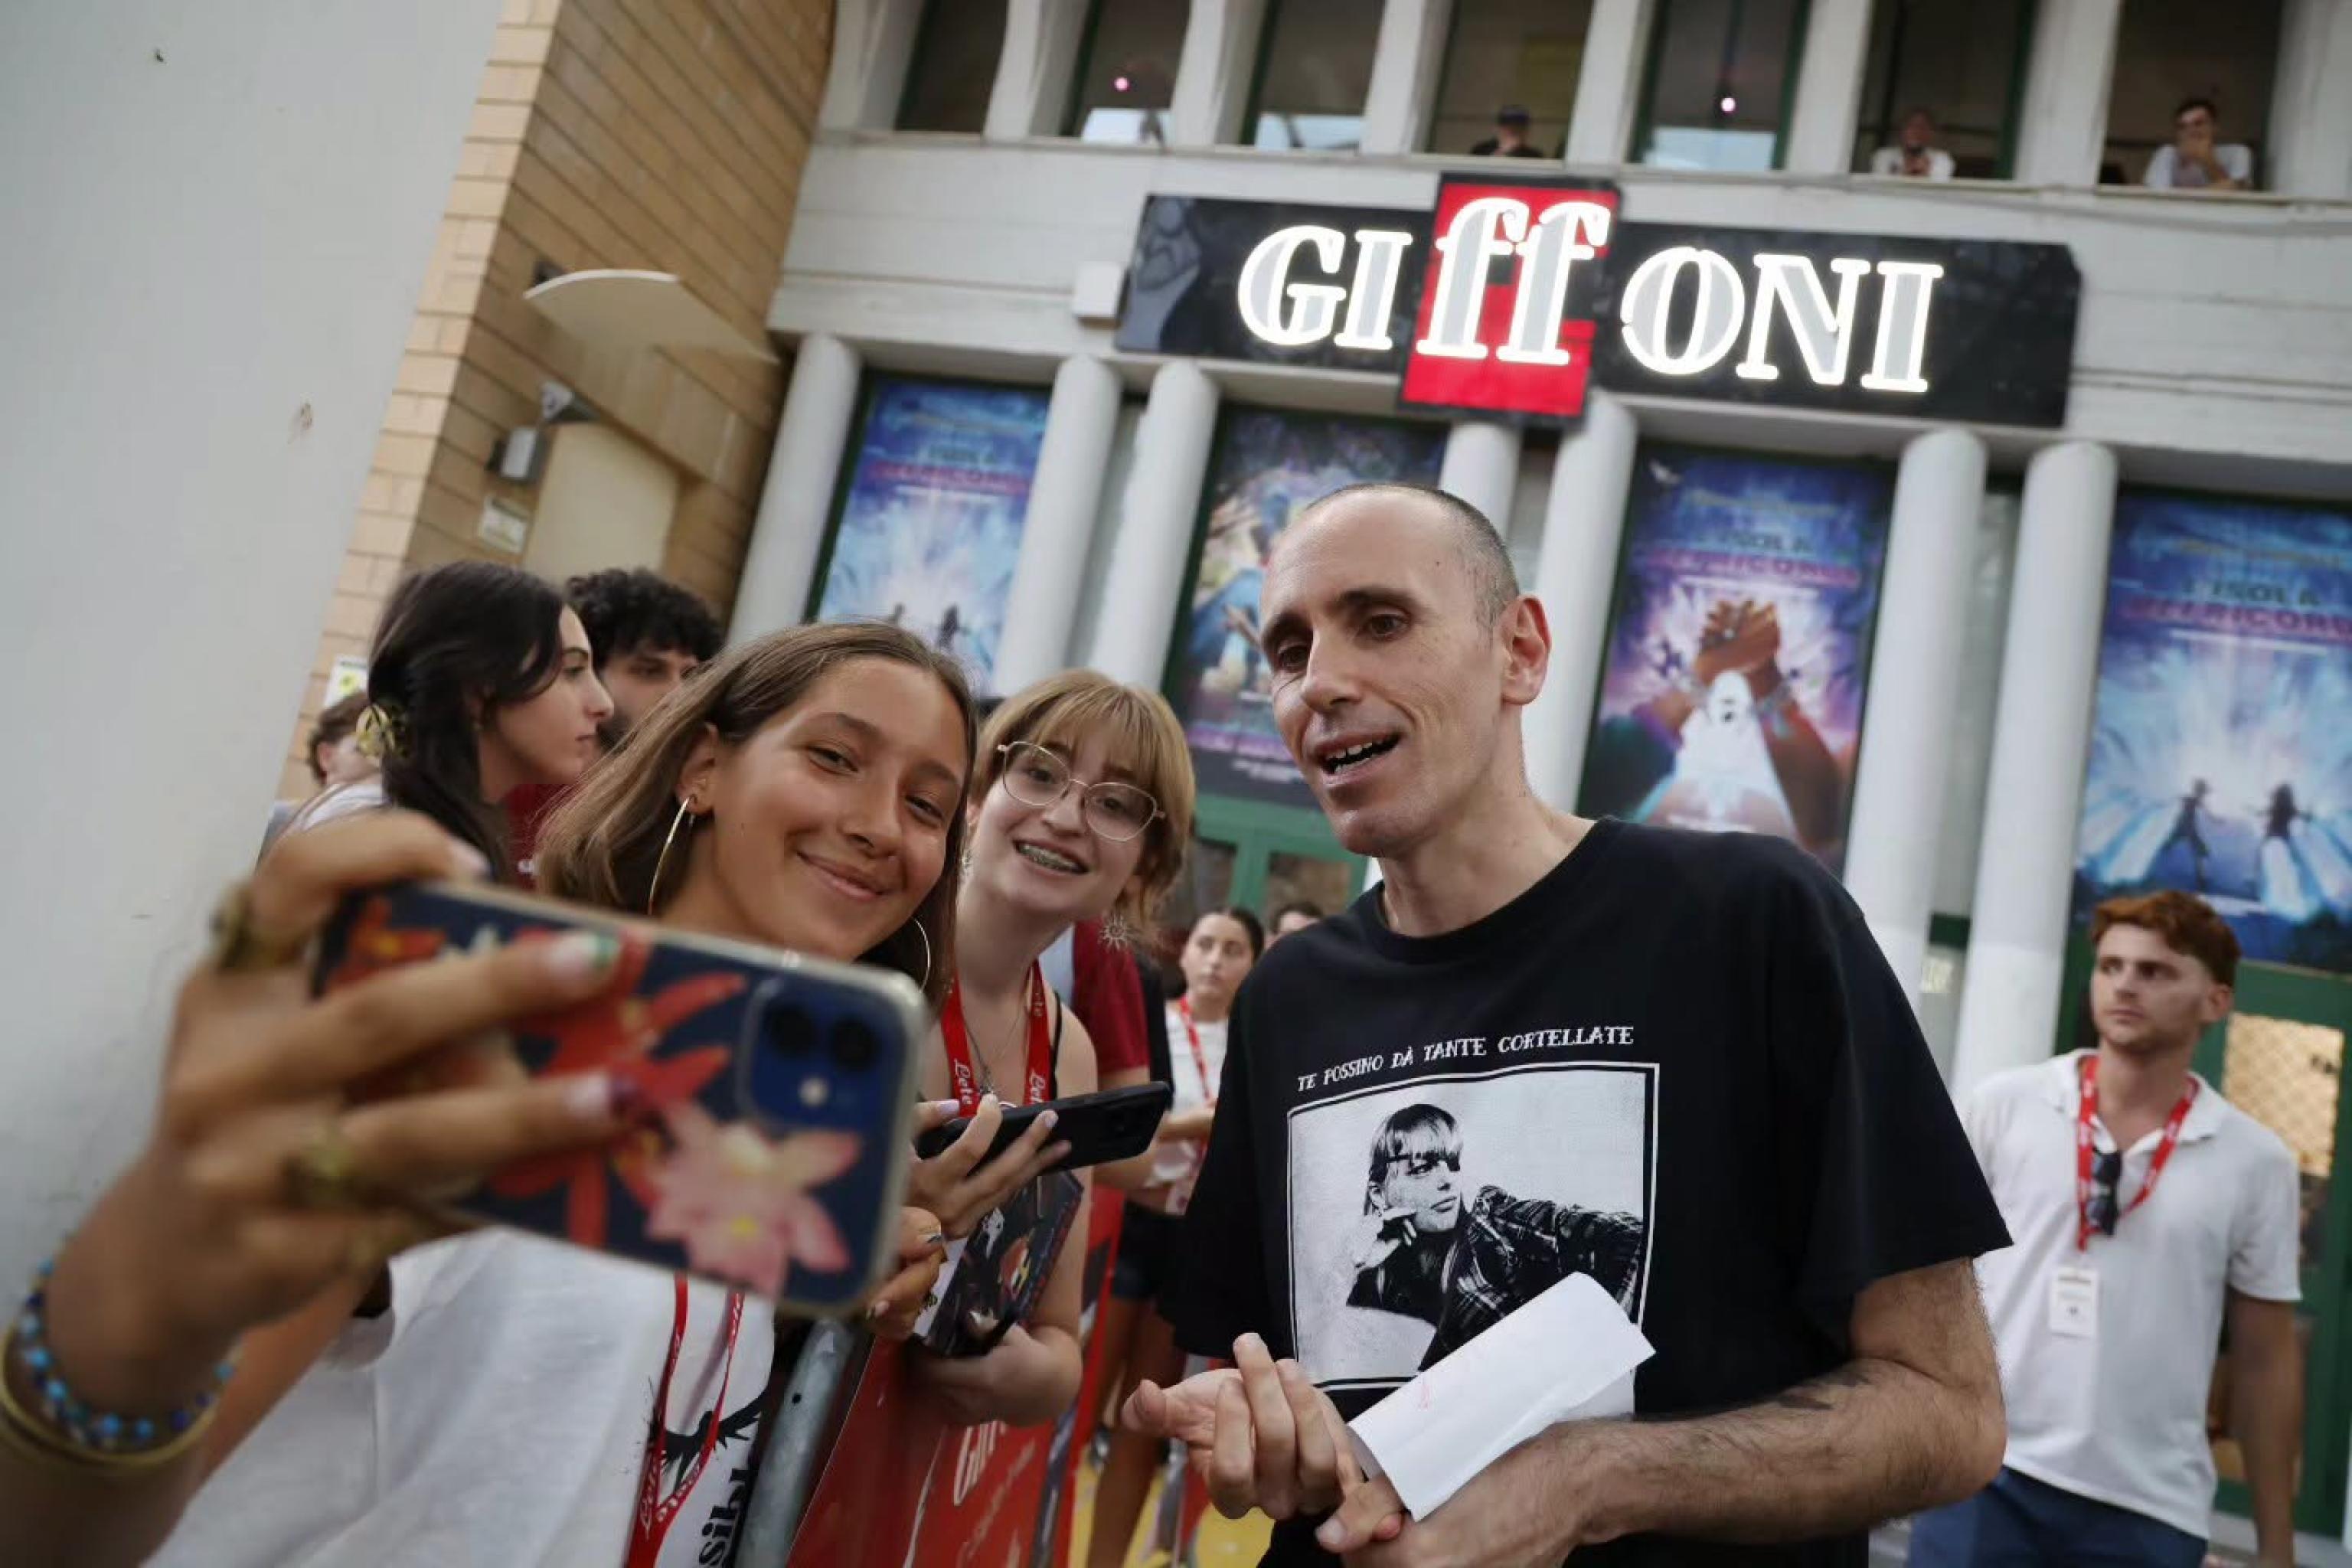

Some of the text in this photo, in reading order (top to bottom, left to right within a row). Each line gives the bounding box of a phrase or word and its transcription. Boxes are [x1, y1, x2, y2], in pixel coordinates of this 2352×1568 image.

[1298, 1026, 1634, 1092] TE POSSINO DÀ TANTE CORTELLATE
